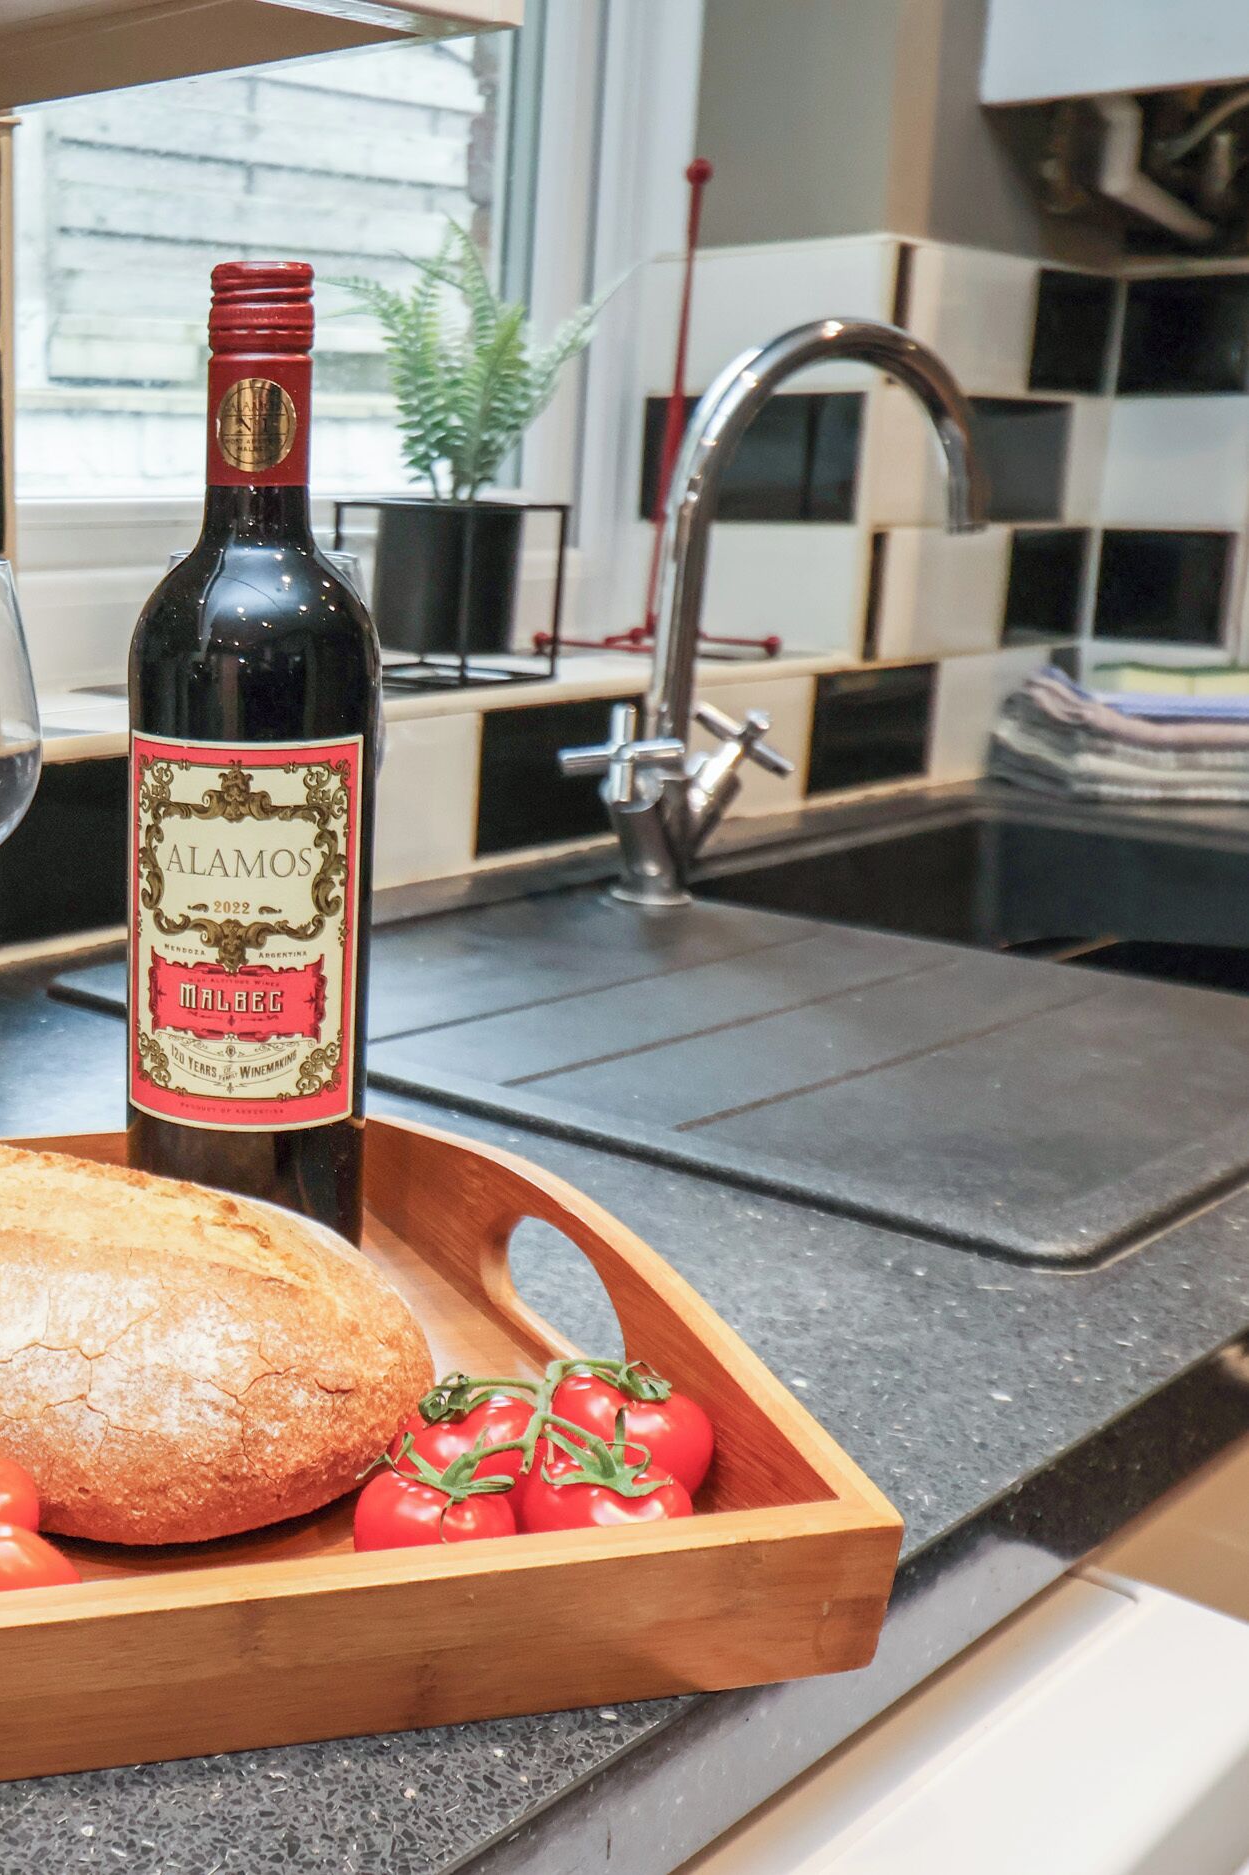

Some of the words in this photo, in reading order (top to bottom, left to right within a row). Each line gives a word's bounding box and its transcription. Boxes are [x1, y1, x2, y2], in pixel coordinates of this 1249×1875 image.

[166, 844, 312, 879] ALAMOS
[213, 901, 251, 915] 2022
[179, 983, 283, 1013] MALBEC
[188, 1056, 217, 1078] YEARS
[240, 1050, 298, 1079] WINEMAKING
